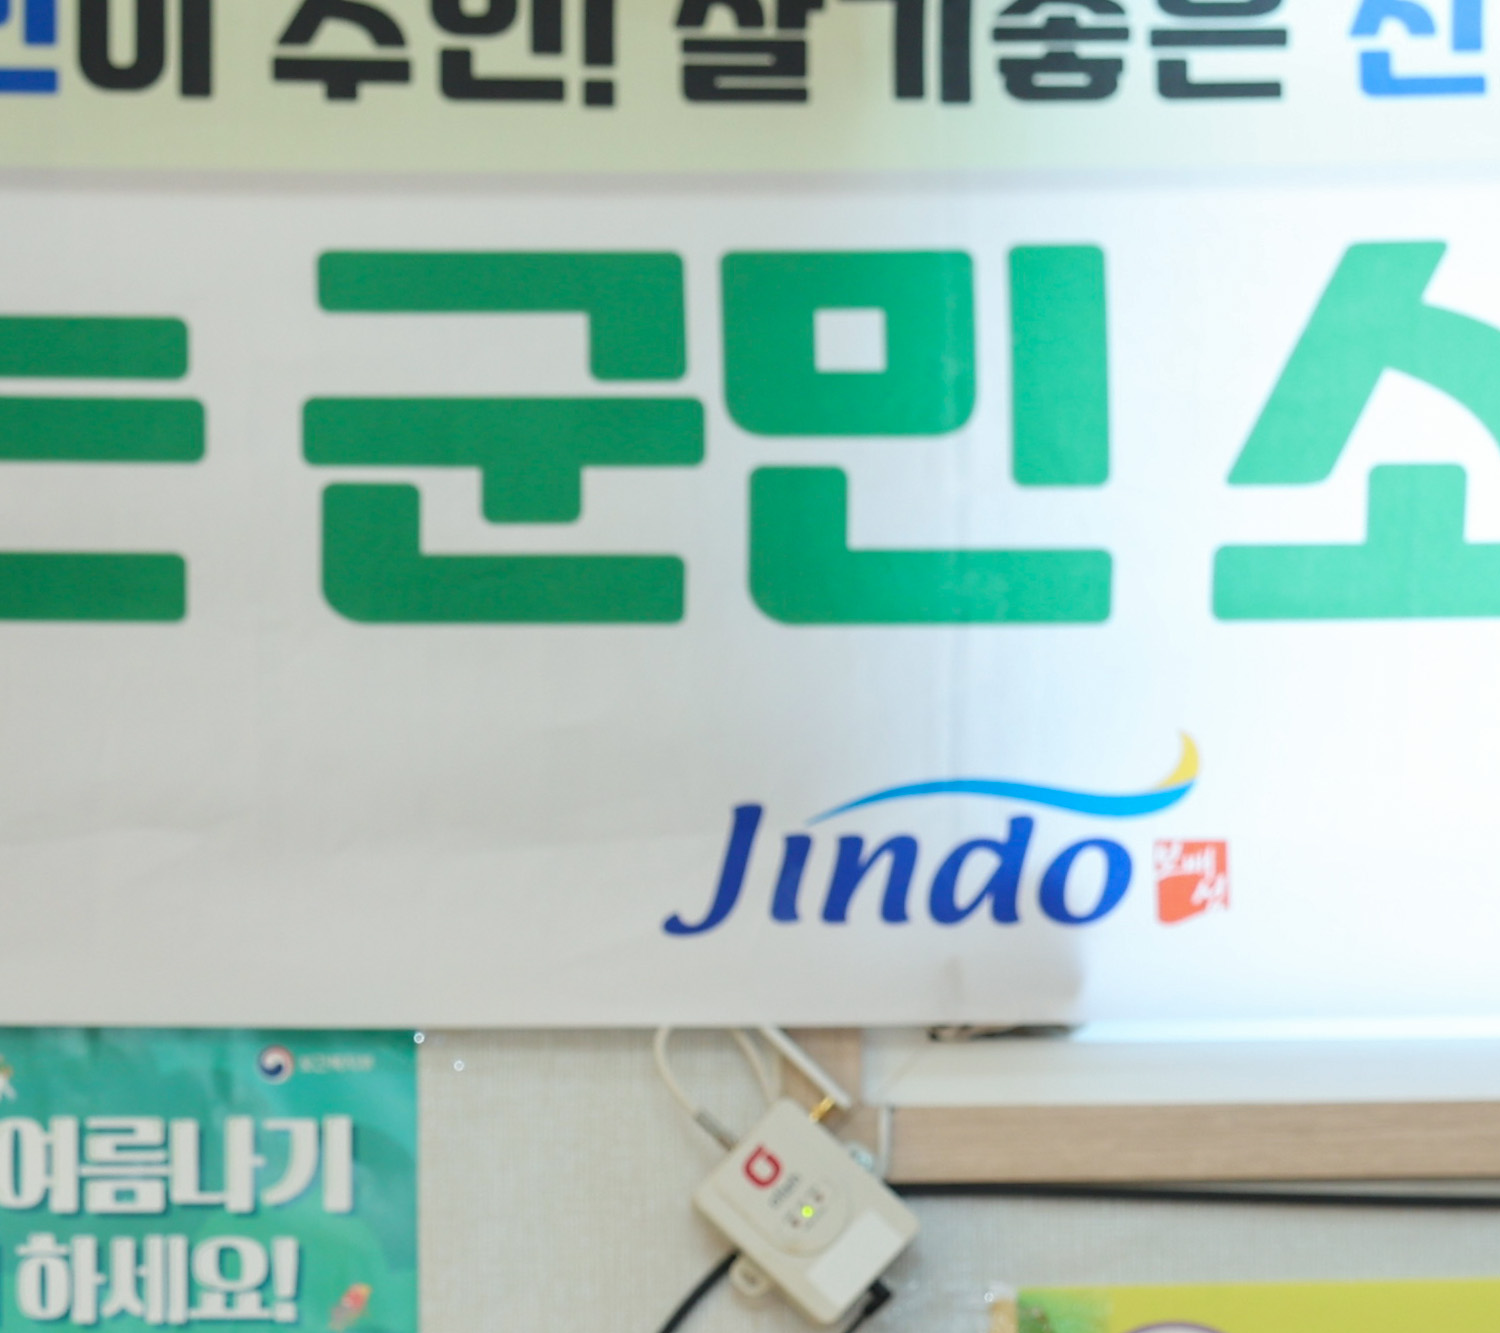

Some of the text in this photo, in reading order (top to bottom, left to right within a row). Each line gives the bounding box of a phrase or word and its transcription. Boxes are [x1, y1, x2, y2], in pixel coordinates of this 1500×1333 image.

[302, 242, 1114, 626] 군민
[661, 803, 1133, 937] Jindo
[15, 1232, 299, 1325] 하세요!
